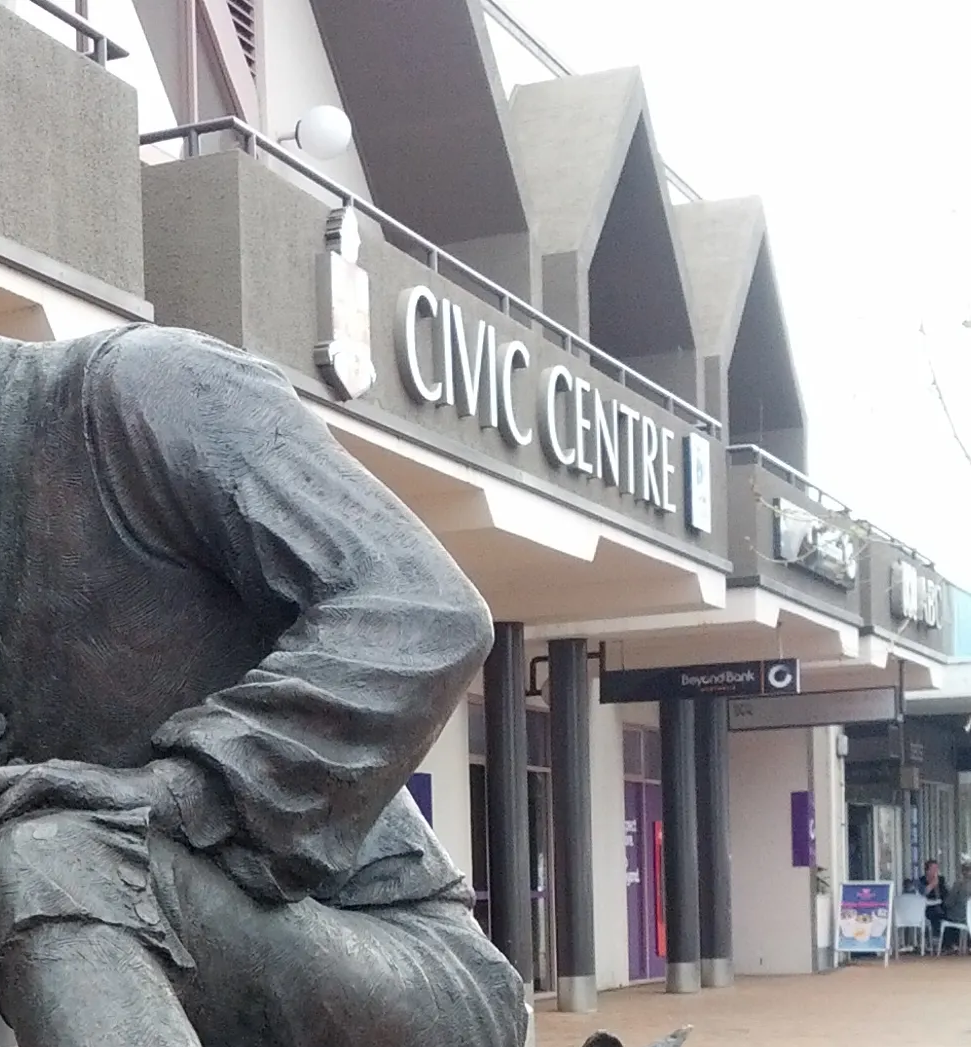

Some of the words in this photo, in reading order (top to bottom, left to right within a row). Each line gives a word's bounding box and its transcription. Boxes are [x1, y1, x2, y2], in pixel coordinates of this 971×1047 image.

[404, 286, 532, 447] CIVIC
[546, 365, 678, 514] CENTRE
[726, 670, 755, 683] Bank
